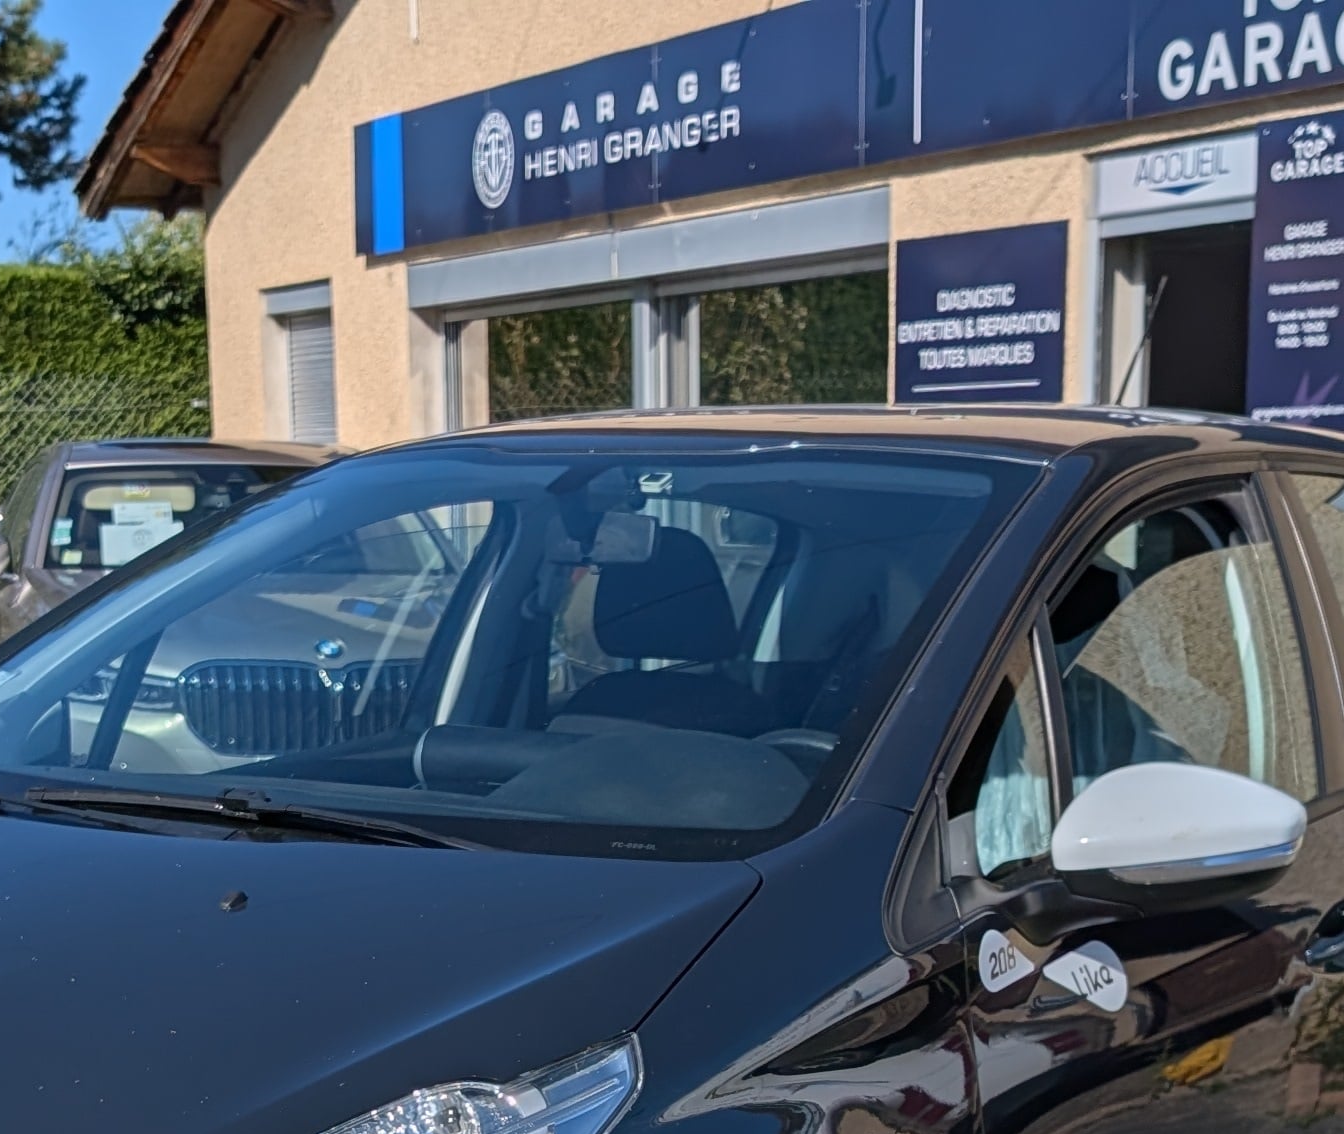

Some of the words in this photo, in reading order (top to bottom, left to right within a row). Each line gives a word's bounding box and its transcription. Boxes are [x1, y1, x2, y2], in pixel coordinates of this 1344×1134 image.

[524, 59, 742, 141] GARAGE
[524, 137, 599, 180] HENRI
[604, 105, 741, 164] GRANGER
[1292, 139, 1329, 160] TOP
[1134, 145, 1230, 187] ACCUEIL
[936, 283, 1016, 312] DIAGNOSTIC
[897, 316, 964, 344] ENTRETIEN
[965, 316, 976, 339] &
[918, 346, 967, 371] TOUTES
[967, 341, 1035, 368] MARQUES
[988, 945, 1017, 981] 208
